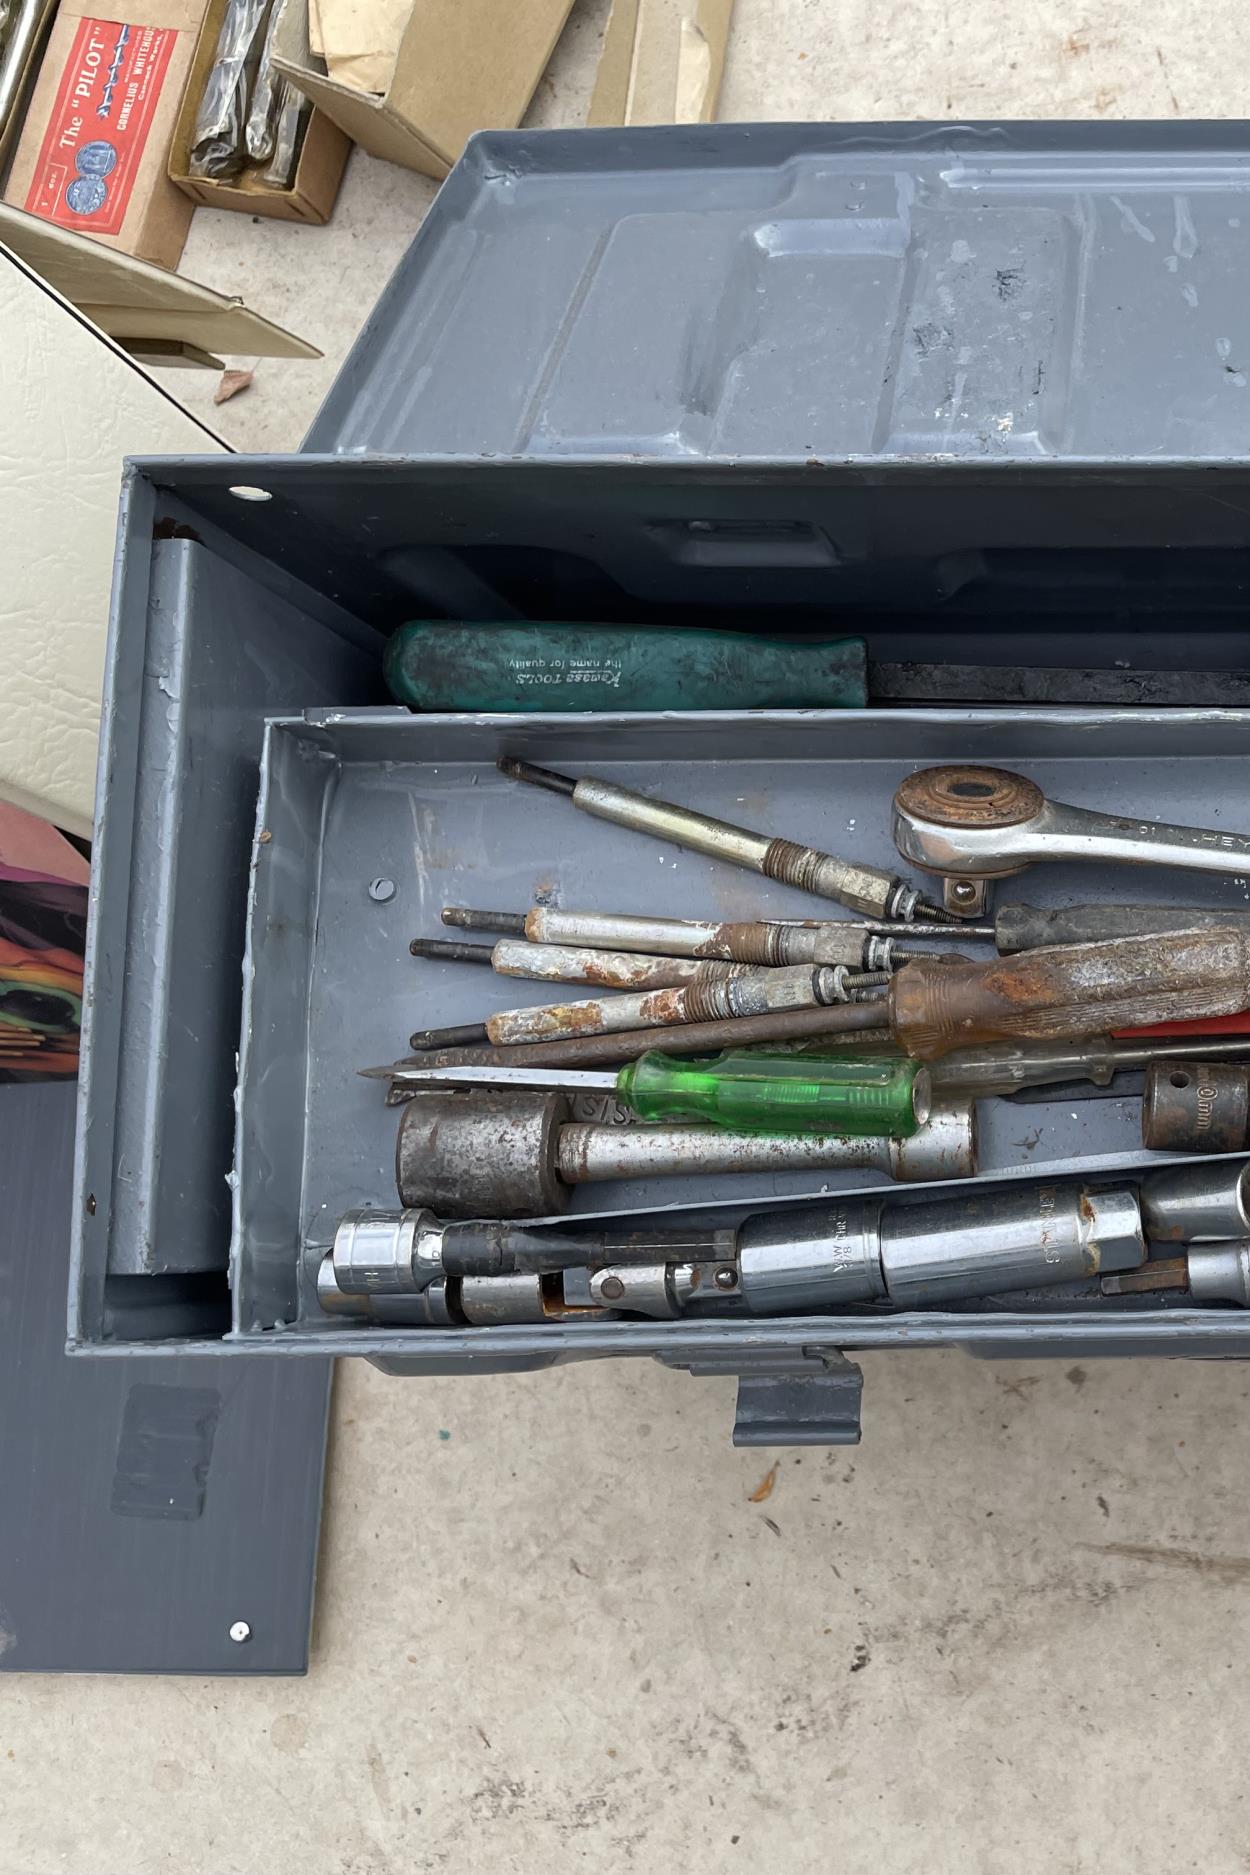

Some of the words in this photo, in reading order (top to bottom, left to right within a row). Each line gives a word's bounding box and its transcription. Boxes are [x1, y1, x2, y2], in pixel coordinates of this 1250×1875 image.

[116, 82, 138, 131] CORNELIUS
[59, 117, 83, 149] The
[509, 658, 545, 669] quality
[549, 659, 565, 669] for
[604, 659, 621, 668] the
